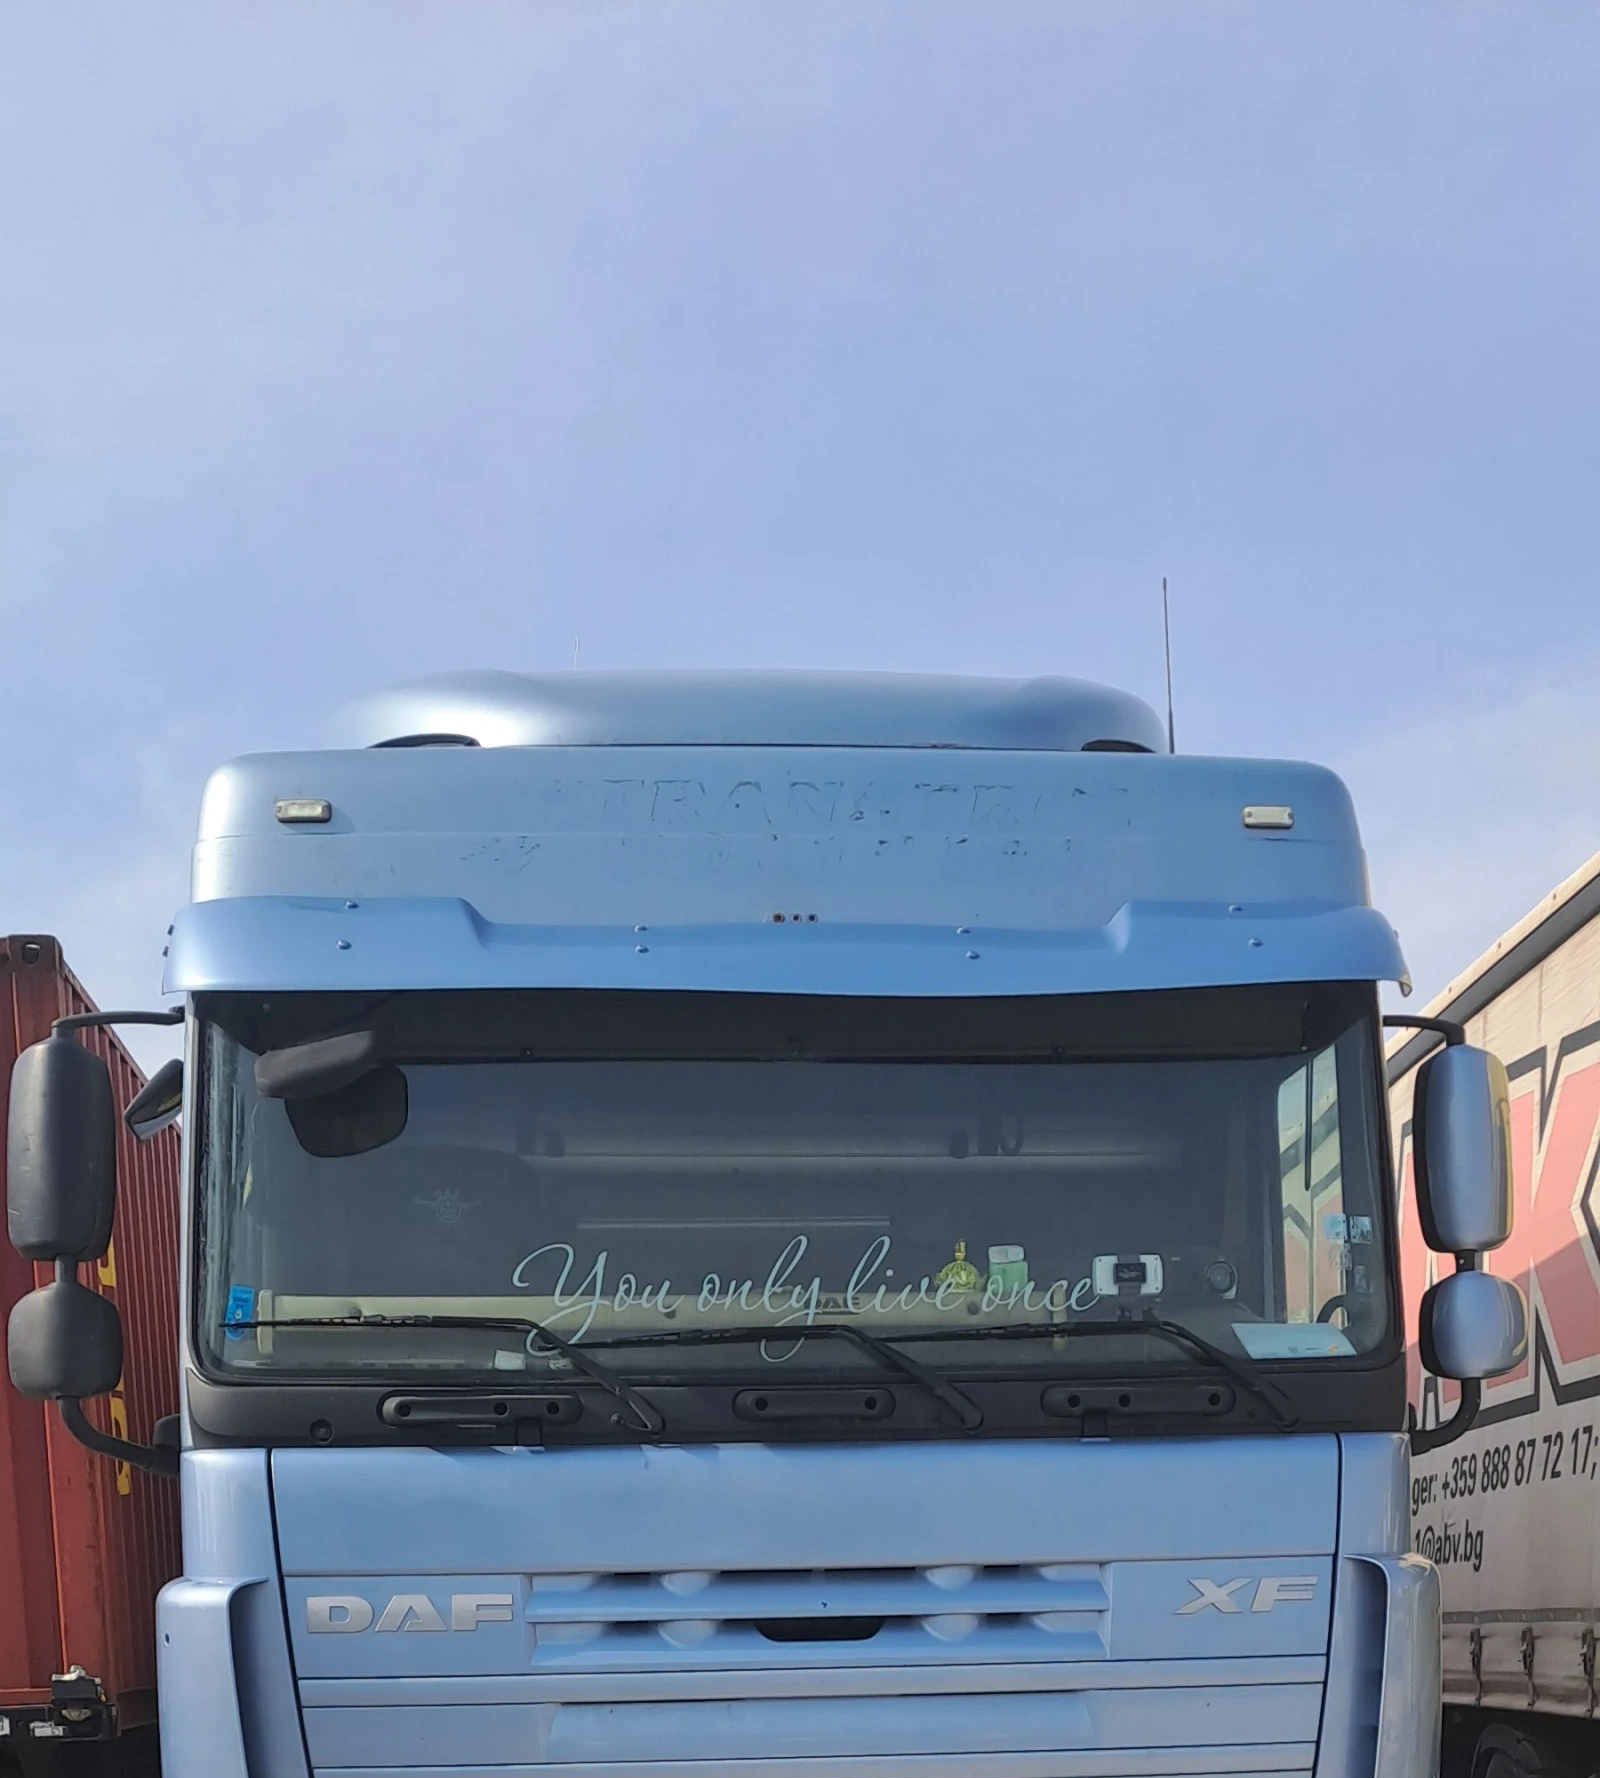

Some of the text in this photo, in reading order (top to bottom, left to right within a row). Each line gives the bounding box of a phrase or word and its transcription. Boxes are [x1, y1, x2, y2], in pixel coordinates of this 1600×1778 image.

[512, 1234, 1101, 1362] You only live once
[1441, 1452, 1478, 1500] +359
[1481, 1444, 1511, 1494] 888
[1514, 1437, 1537, 1487] 87
[1541, 1430, 1564, 1482] 72
[306, 1594, 514, 1634] DAF
[1172, 1575, 1319, 1615] XF
